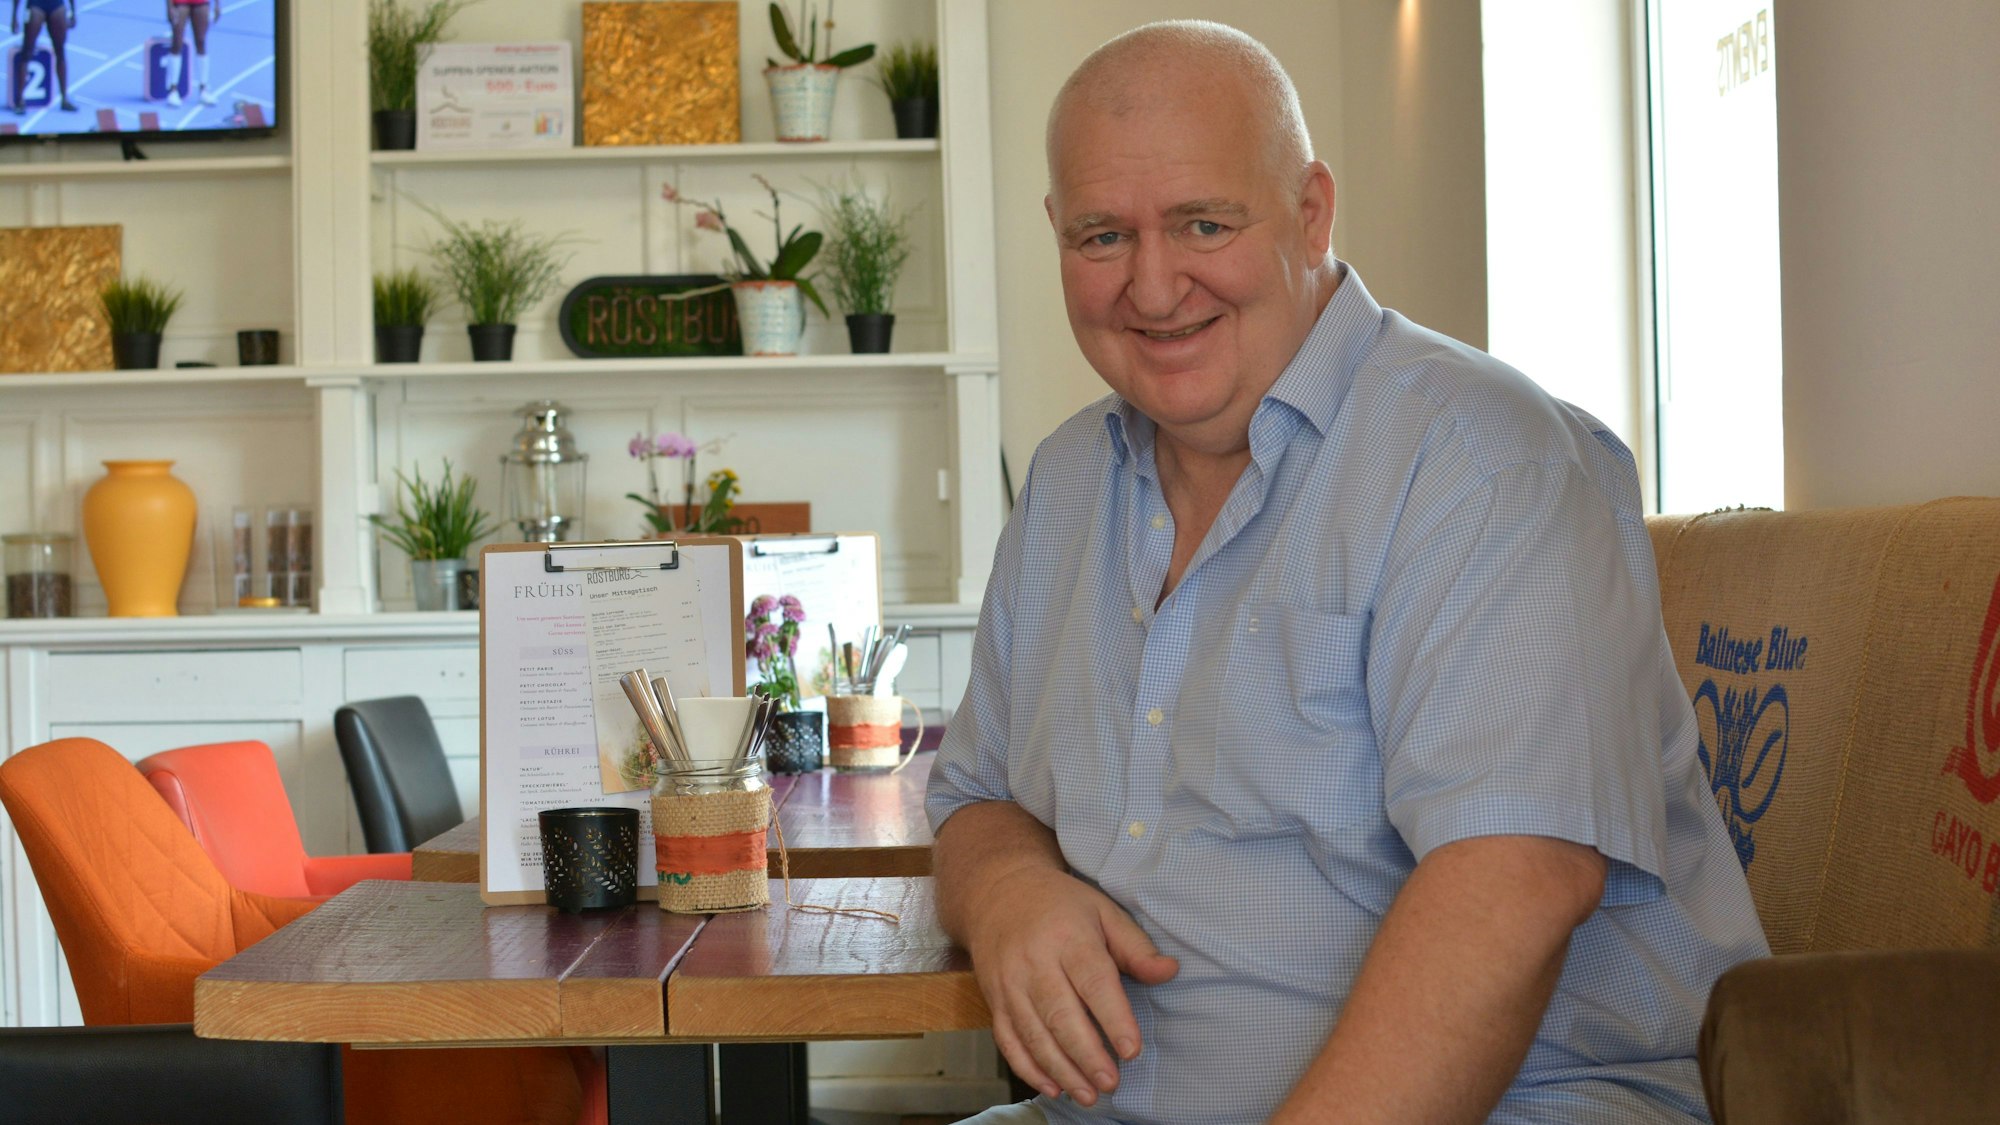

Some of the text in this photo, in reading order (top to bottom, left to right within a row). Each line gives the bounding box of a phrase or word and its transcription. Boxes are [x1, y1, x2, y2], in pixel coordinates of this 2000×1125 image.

[23, 60, 47, 100] 2
[586, 568, 631, 585] RÖSTBURG
[589, 586, 658, 599] Unser Mittagstisch
[1764, 624, 1808, 671] Blue
[544, 746, 580, 755] RÜHREI
[1932, 810, 1982, 880] GAYO
